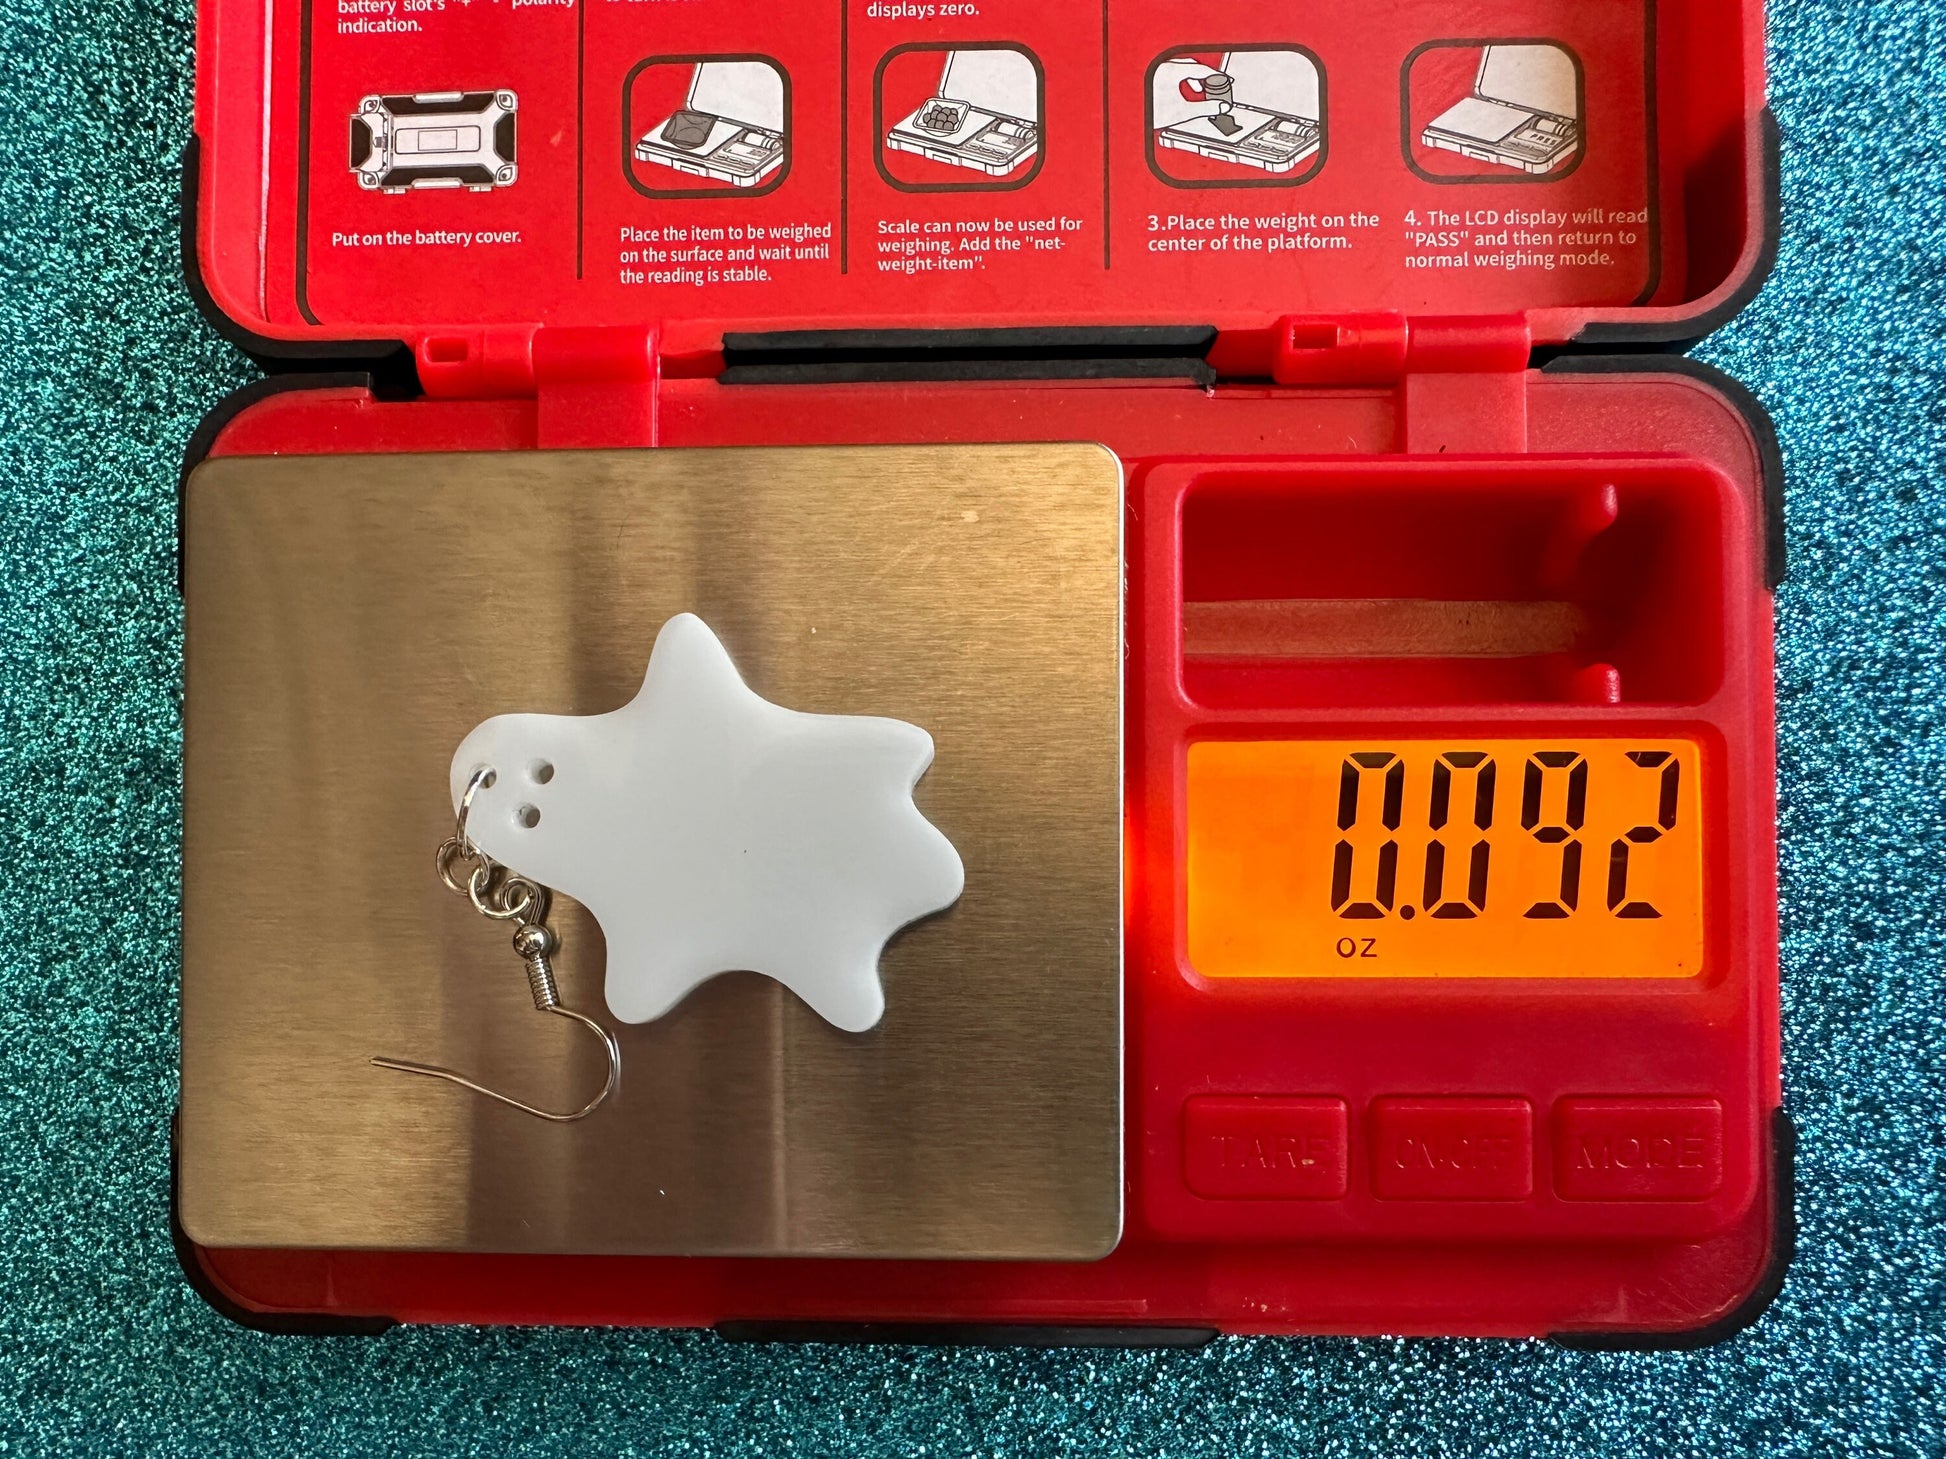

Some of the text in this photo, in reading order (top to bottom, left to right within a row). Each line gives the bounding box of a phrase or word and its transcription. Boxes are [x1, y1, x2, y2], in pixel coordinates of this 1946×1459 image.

[338, 0, 396, 15] battery
[867, 1, 979, 20] displays zero.
[338, 17, 422, 33] indication.
[878, 217, 1083, 233] Scale can now be used for
[1148, 212, 1379, 232] 3.Place the weight on the
[1404, 207, 1647, 228] 4. The LCD display will read
[333, 230, 521, 247] Put on the battery cover.
[621, 222, 831, 242] Place the item to be weighed
[1406, 230, 1636, 247] "PASS" and then return to
[620, 243, 829, 262] on the surface and wait until
[878, 236, 1065, 255] weighing. Add the "net-
[1149, 233, 1352, 253] center of the platform.
[878, 256, 985, 274] weight-item".
[1406, 250, 1614, 270] normal weighing mode.
[620, 266, 771, 286] the reading is stable.
[1331, 751, 1680, 920] 0.092
[1576, 1137, 1705, 1169] MODE
